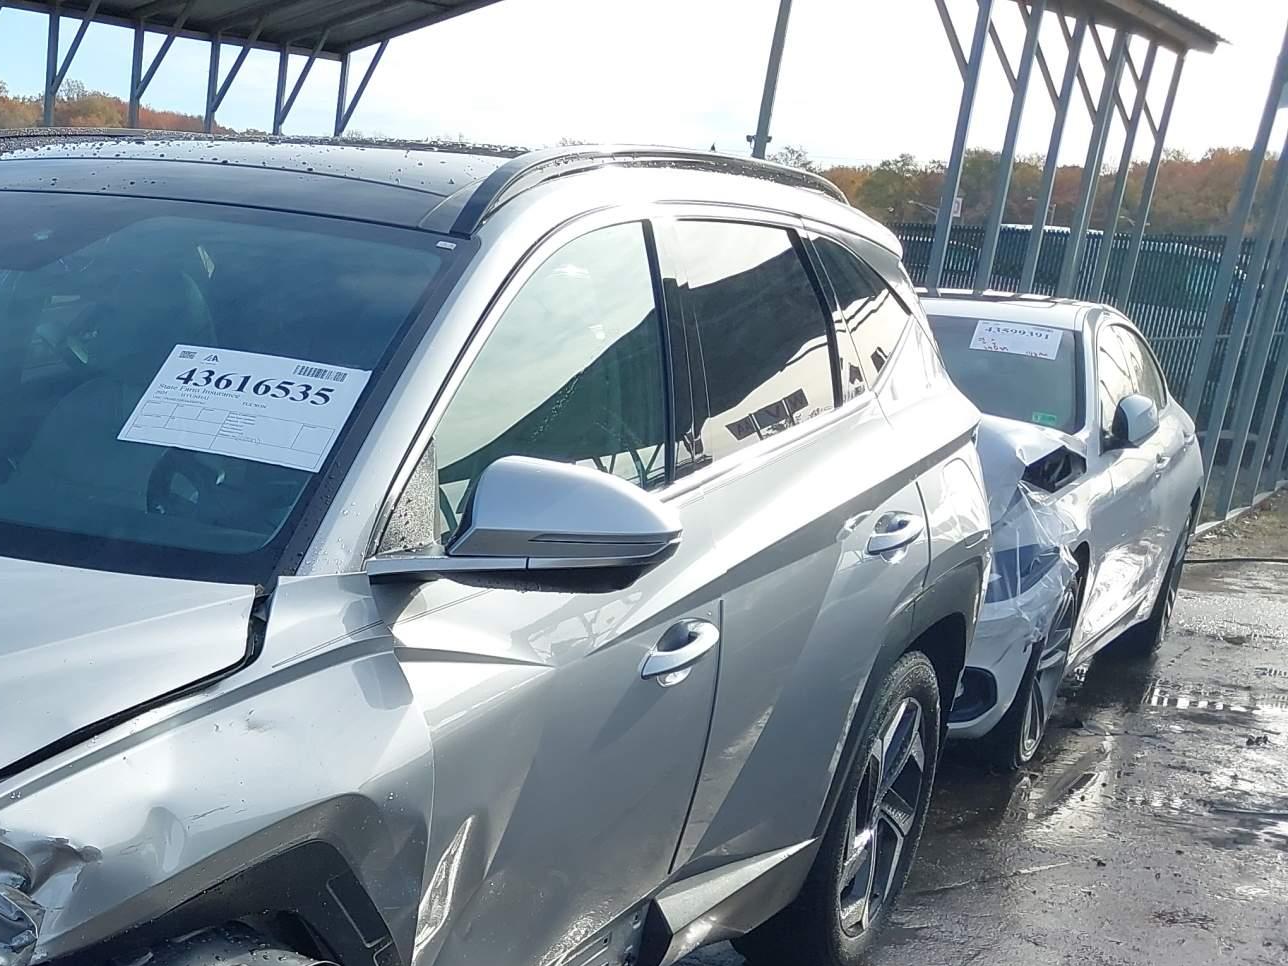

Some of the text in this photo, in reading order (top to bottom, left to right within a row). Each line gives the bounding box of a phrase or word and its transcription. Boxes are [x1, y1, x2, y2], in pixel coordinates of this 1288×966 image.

[158, 383, 179, 391] State
[202, 388, 242, 400] Insurance
[175, 367, 336, 406] 43616535
